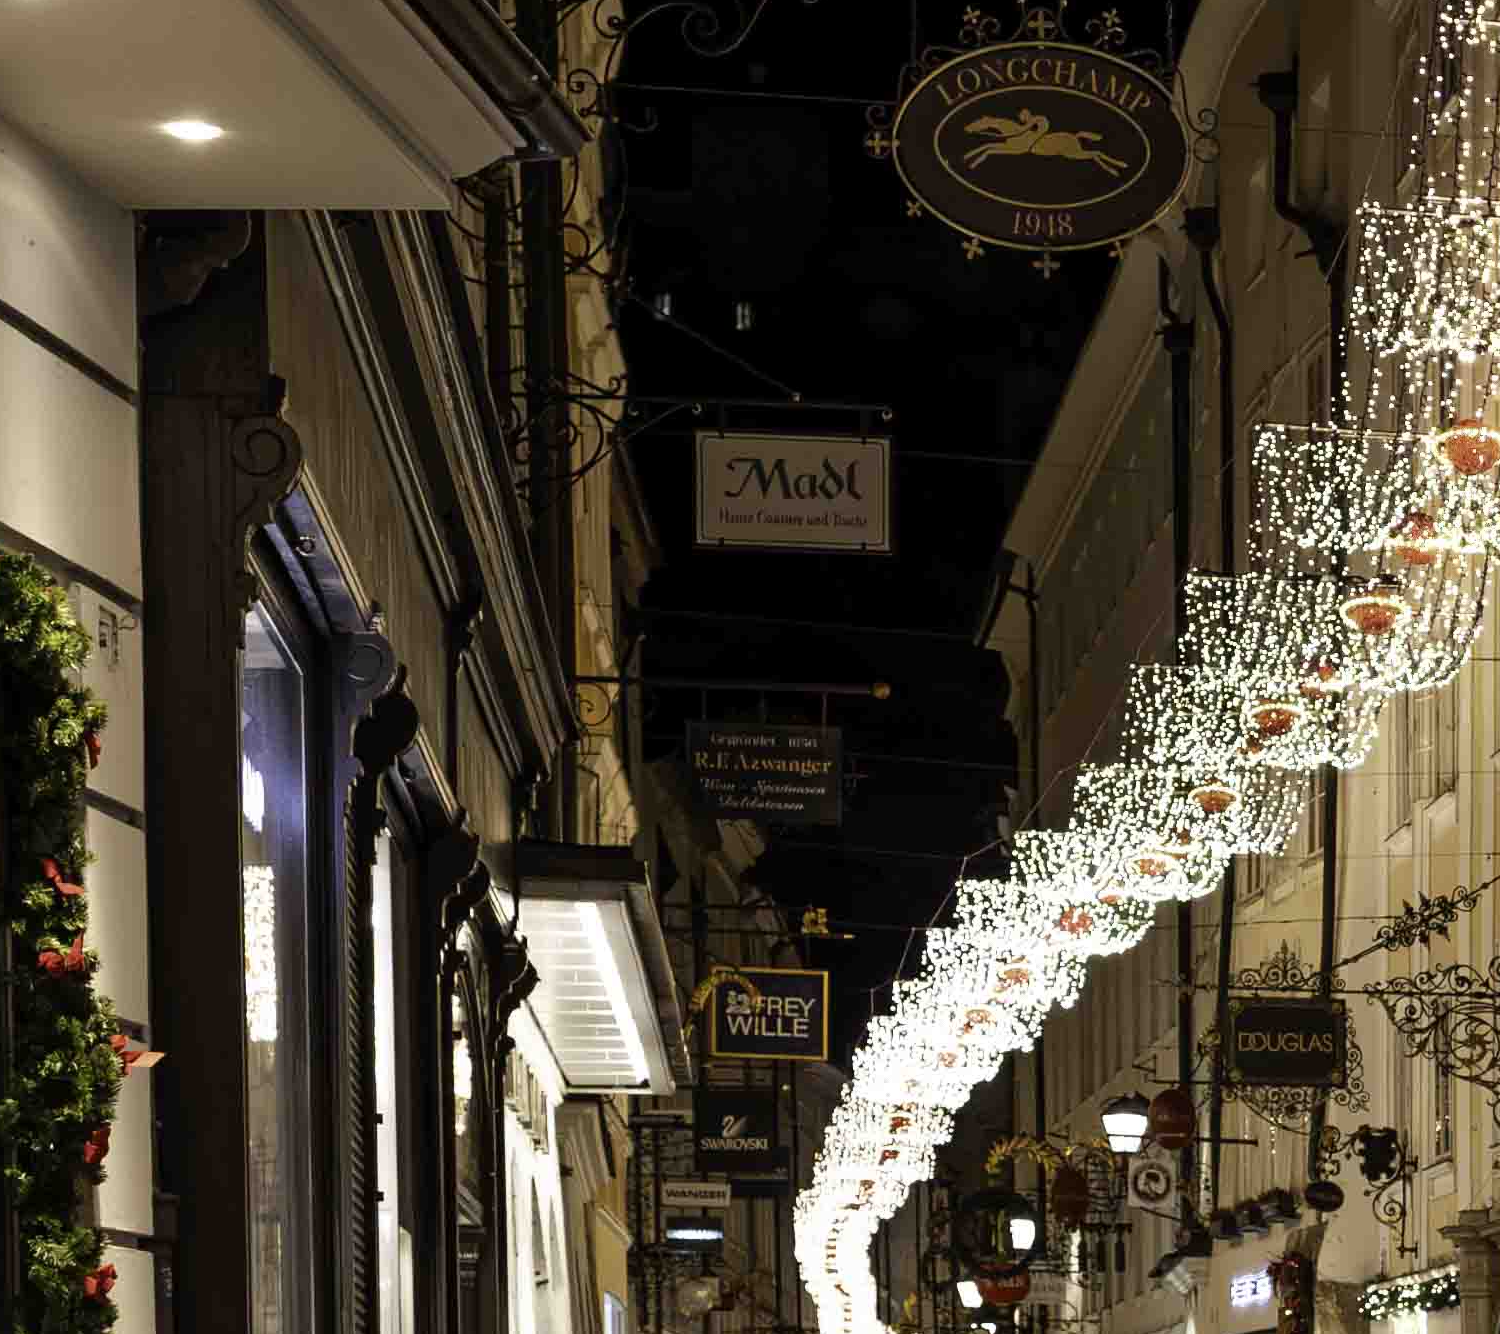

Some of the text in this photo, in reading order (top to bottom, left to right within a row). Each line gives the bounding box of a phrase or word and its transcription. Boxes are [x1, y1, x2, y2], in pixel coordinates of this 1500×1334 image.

[936, 56, 1153, 114] LONGCHAMP
[1011, 210, 1075, 238] 1948
[724, 457, 863, 501] Madl
[756, 995, 817, 1018] FREY
[726, 1015, 811, 1039] WILLE
[1238, 1032, 1333, 1052] DOUGLAS
[700, 1137, 769, 1151] SWAROVSKI
